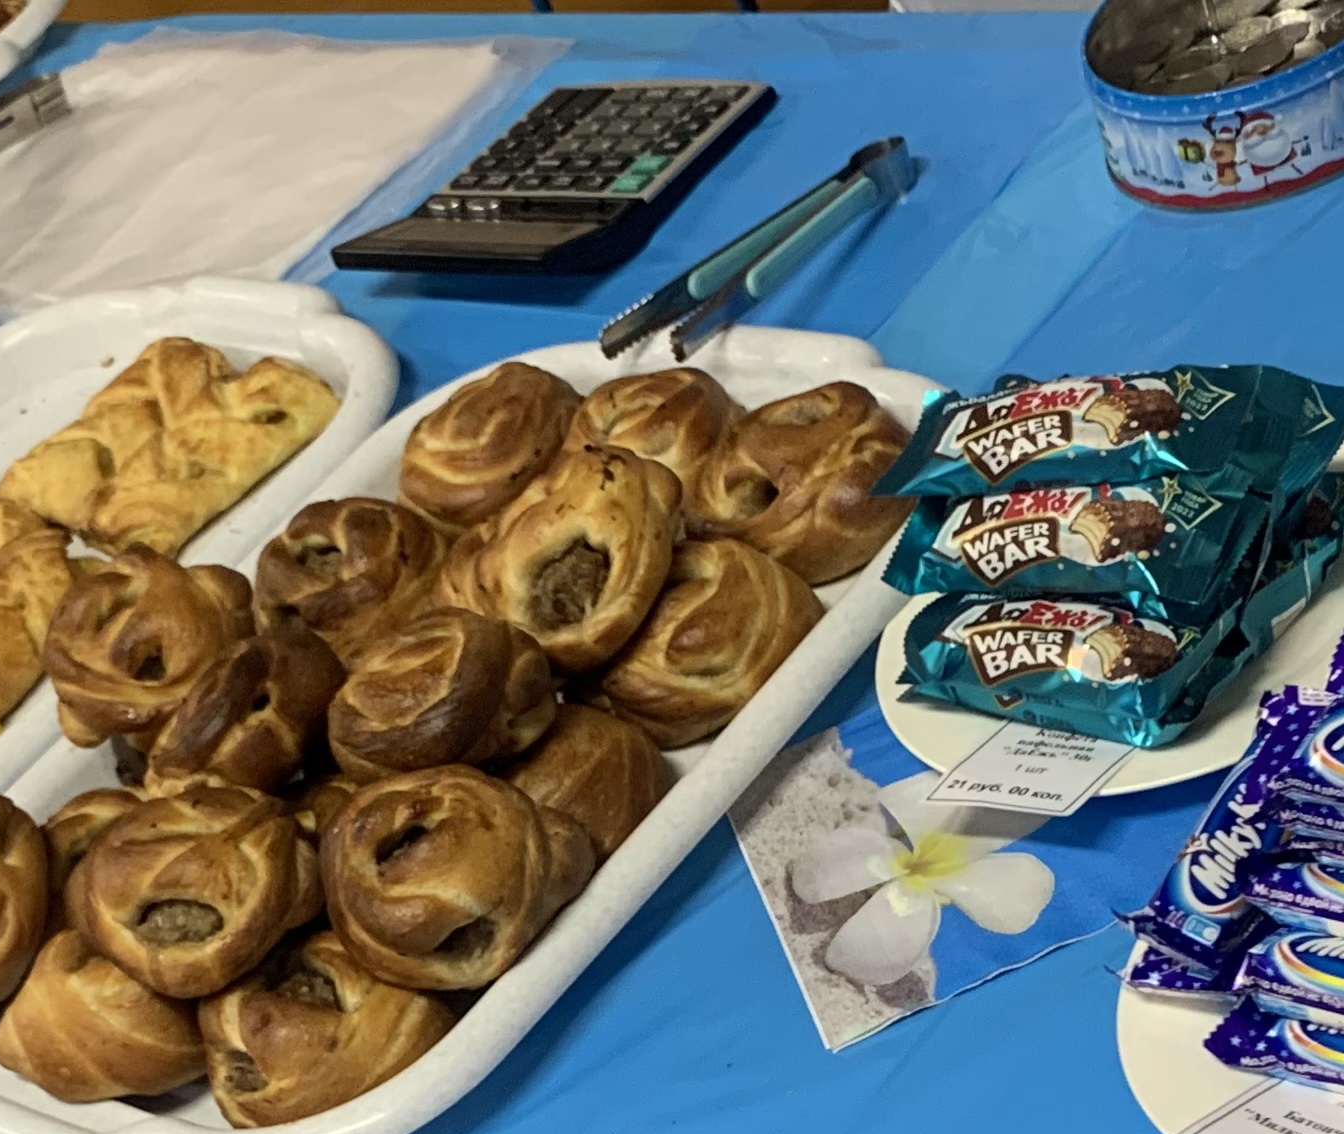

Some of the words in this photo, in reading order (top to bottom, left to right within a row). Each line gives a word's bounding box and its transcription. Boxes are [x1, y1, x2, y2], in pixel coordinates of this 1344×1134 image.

[968, 413, 1063, 453] WAFER
[981, 427, 1064, 477] BAR
[962, 520, 1051, 557] WAFER
[976, 536, 1058, 581] BAR
[972, 629, 1065, 654] WAFER
[982, 643, 1066, 679] BAR
[1014, 763, 1024, 772] 1
[1025, 764, 1049, 774] шт
[946, 779, 967, 790] 21
[968, 781, 1003, 794] руб.
[1008, 785, 1031, 796] 00
[1031, 789, 1064, 802] коп.
